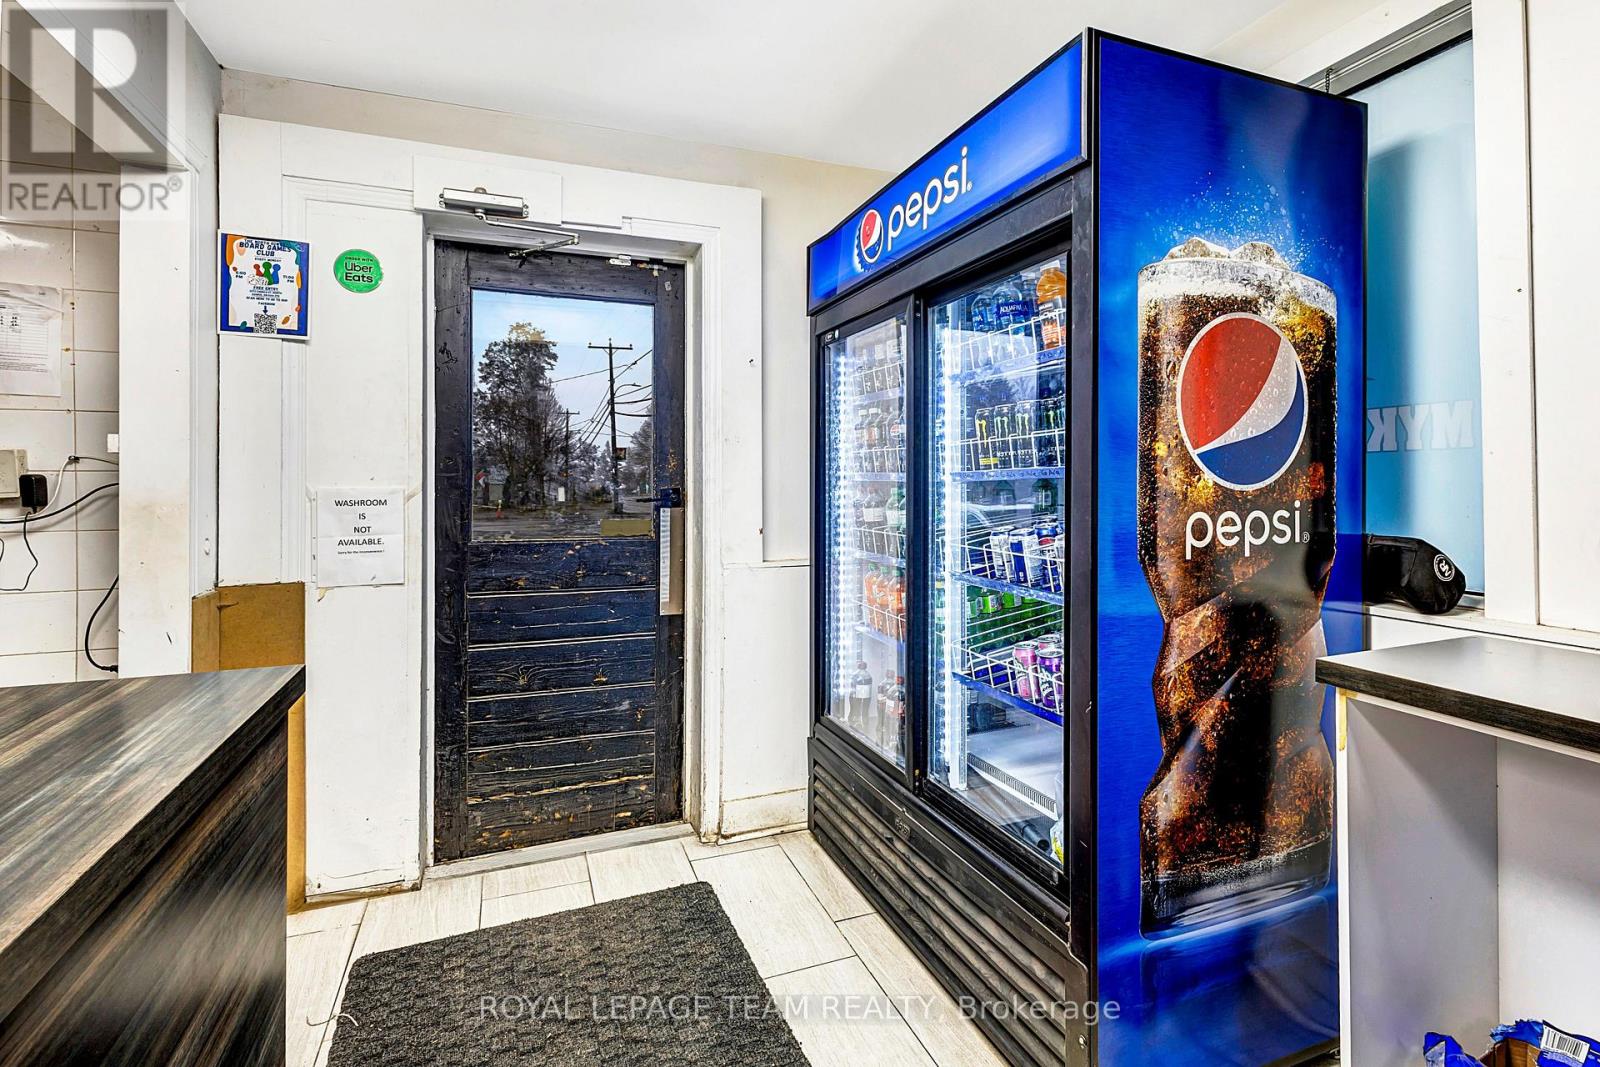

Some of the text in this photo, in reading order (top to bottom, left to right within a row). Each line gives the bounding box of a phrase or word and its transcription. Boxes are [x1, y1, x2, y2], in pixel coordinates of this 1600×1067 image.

[239, 242, 265, 250] BOARD
[267, 245, 291, 253] GAMES
[345, 262, 373, 273] Uber
[345, 272, 374, 283] Eats
[334, 499, 388, 507] WASHROOM
[353, 526, 372, 534] NOT
[337, 538, 384, 546] AVAILABLE.
